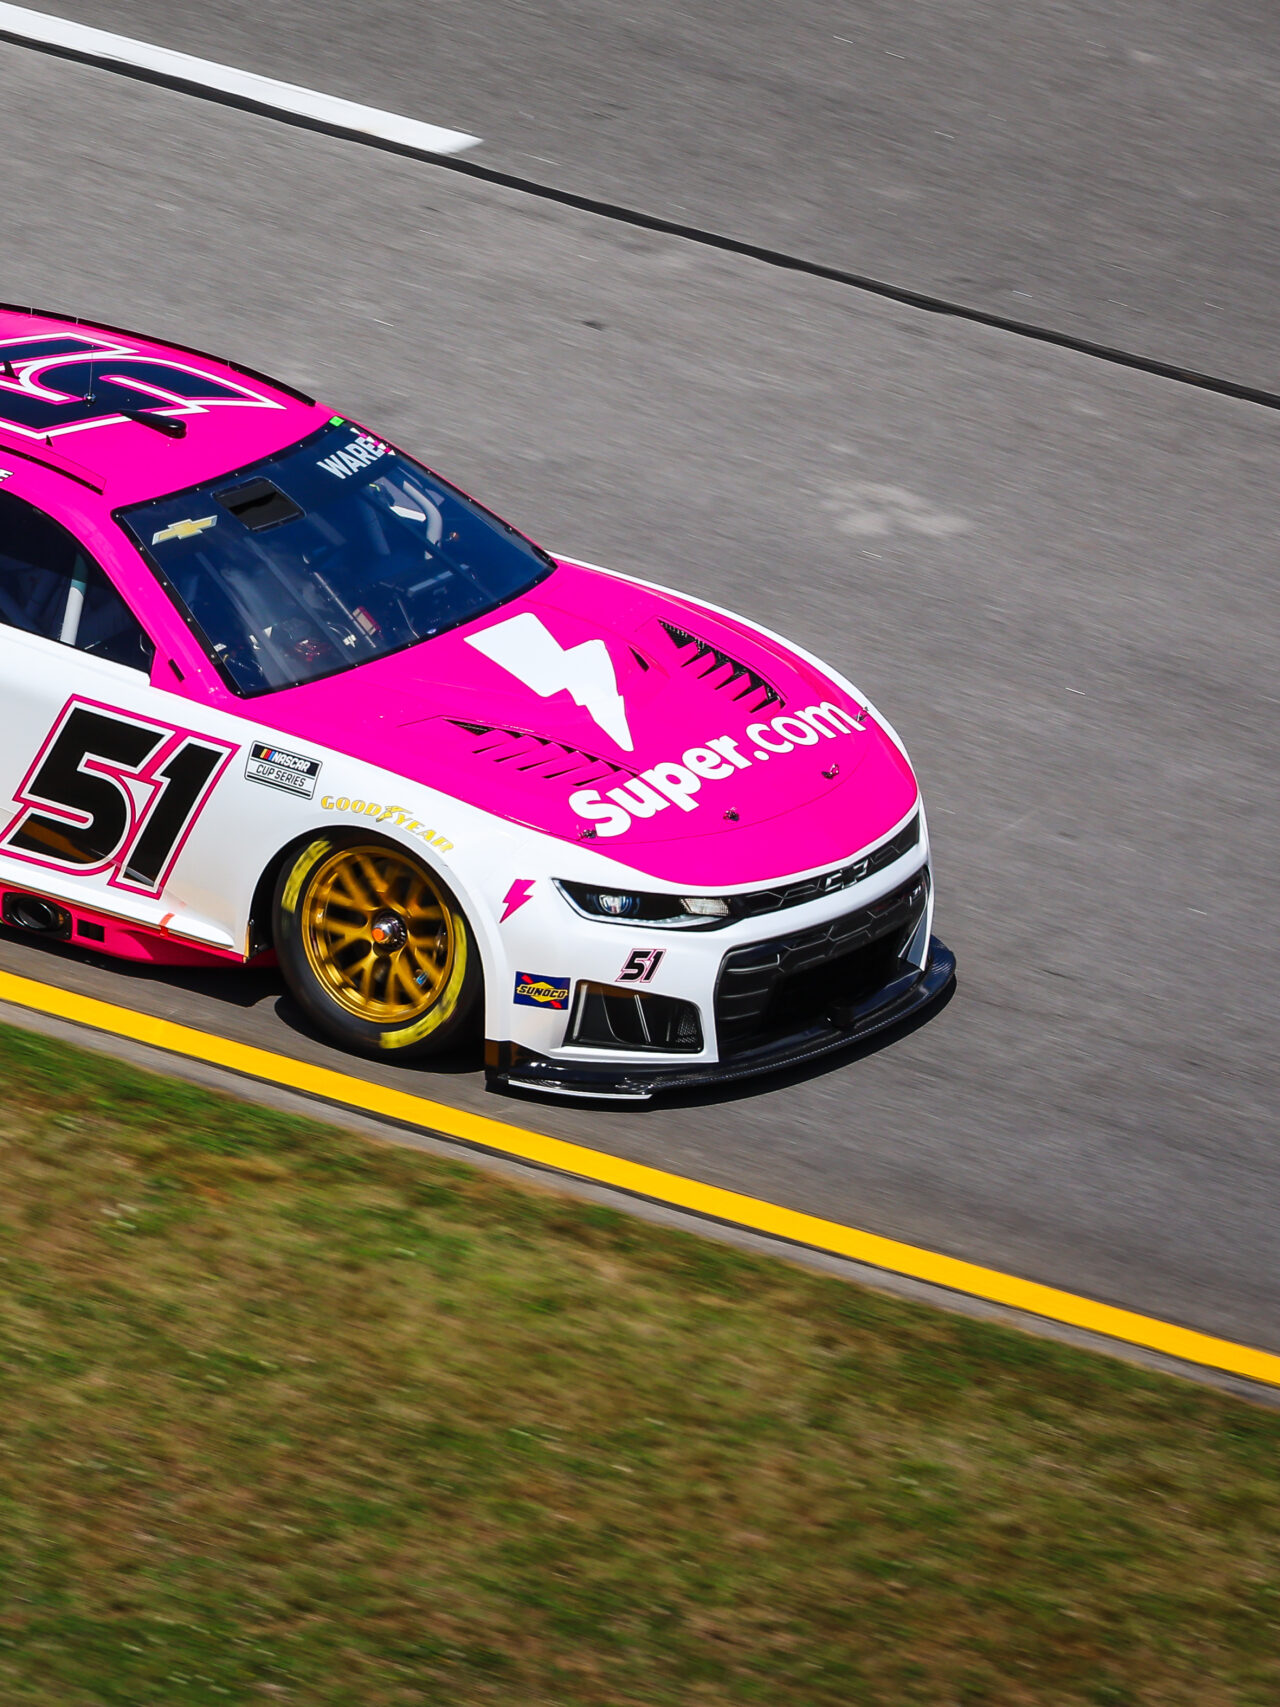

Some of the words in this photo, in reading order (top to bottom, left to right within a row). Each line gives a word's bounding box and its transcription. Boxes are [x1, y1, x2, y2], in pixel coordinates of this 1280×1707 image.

[316, 436, 385, 479] WARE
[255, 764, 275, 777] CUP
[276, 770, 306, 788] SERIES
[271, 751, 311, 773] NASCAR
[569, 698, 867, 838] Super.com
[617, 949, 665, 982] 51
[519, 985, 569, 999] SUNOCO
